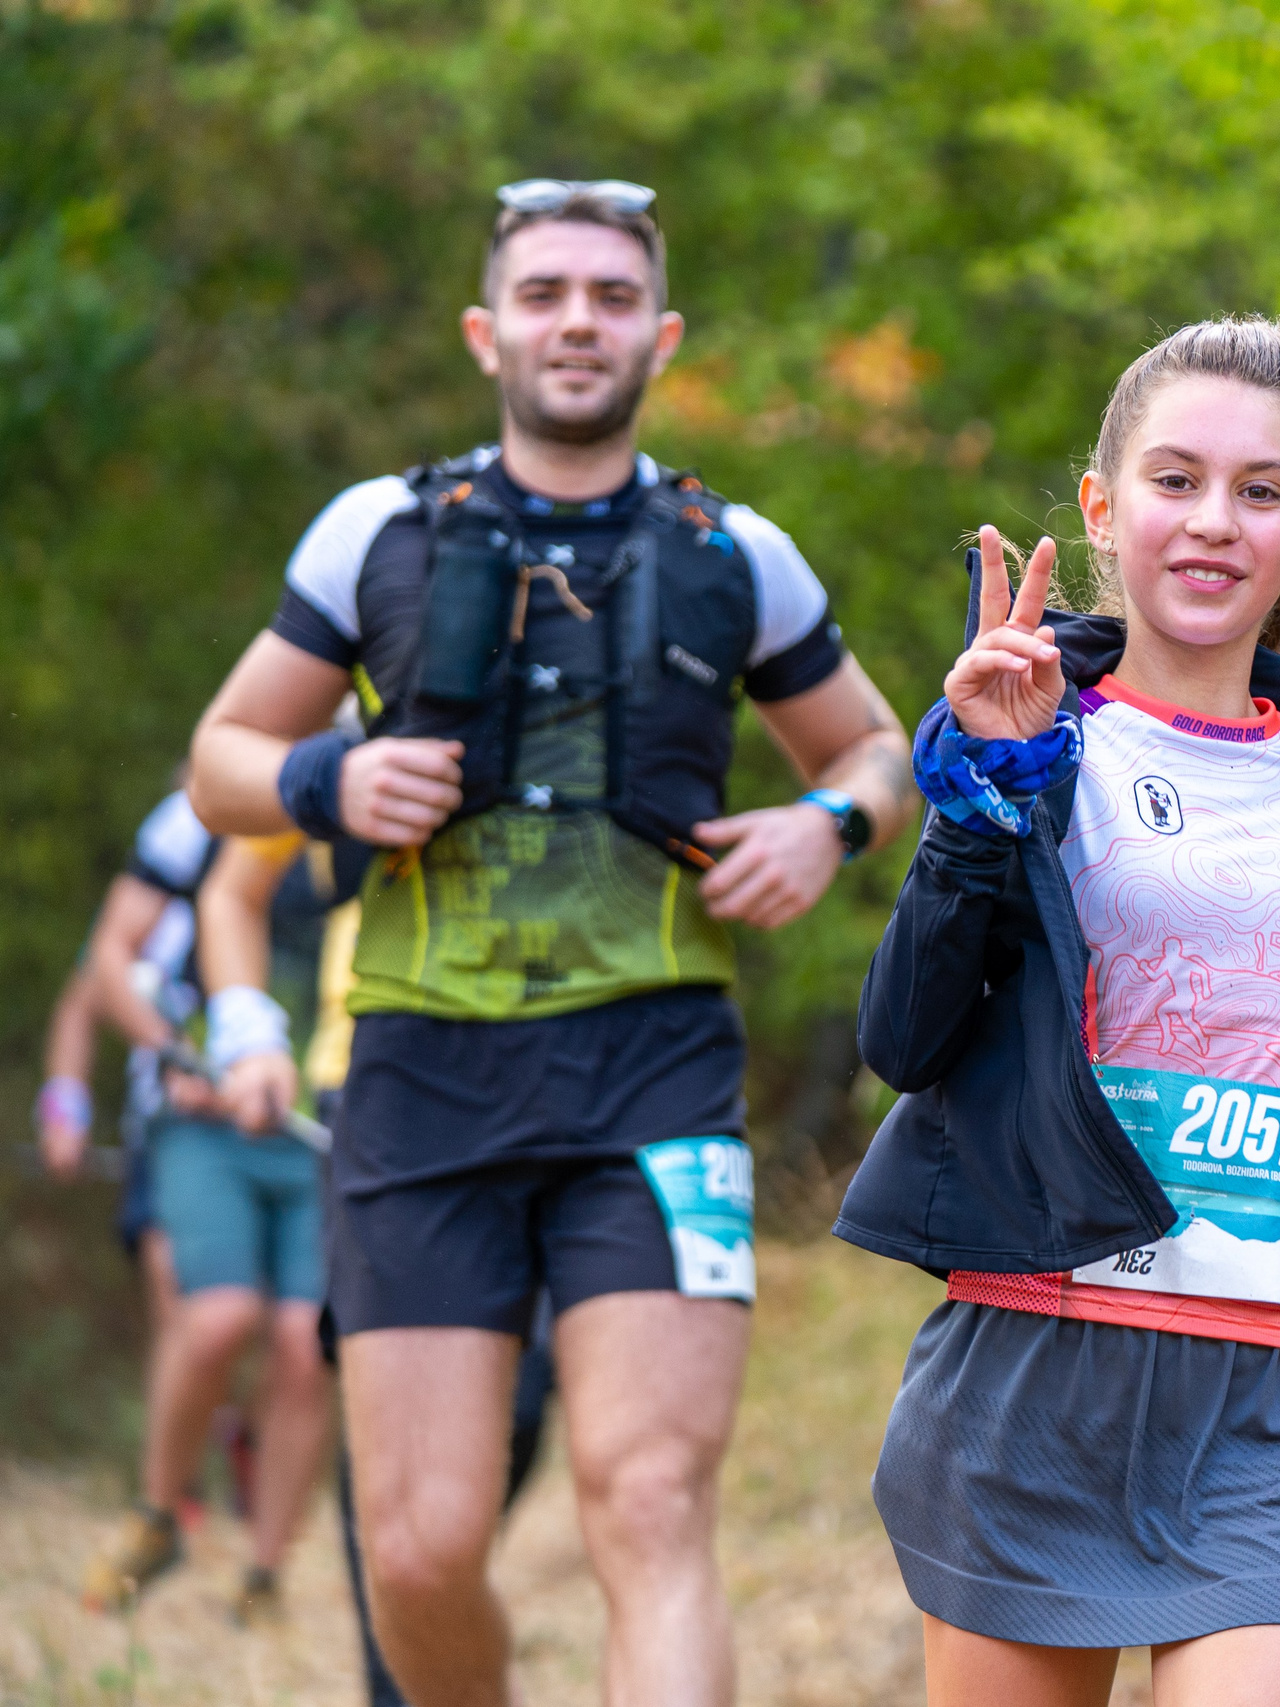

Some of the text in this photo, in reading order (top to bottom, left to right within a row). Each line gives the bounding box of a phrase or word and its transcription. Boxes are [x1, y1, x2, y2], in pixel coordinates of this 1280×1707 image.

[1172, 713, 1266, 742] GOLD BORDER RACE
[1125, 1088, 1159, 1102] ULTRA
[1183, 1159, 1224, 1175] TODOROVA,
[1226, 1164, 1269, 1180] BOZHIDARA
[1112, 1250, 1156, 1275] 23K
